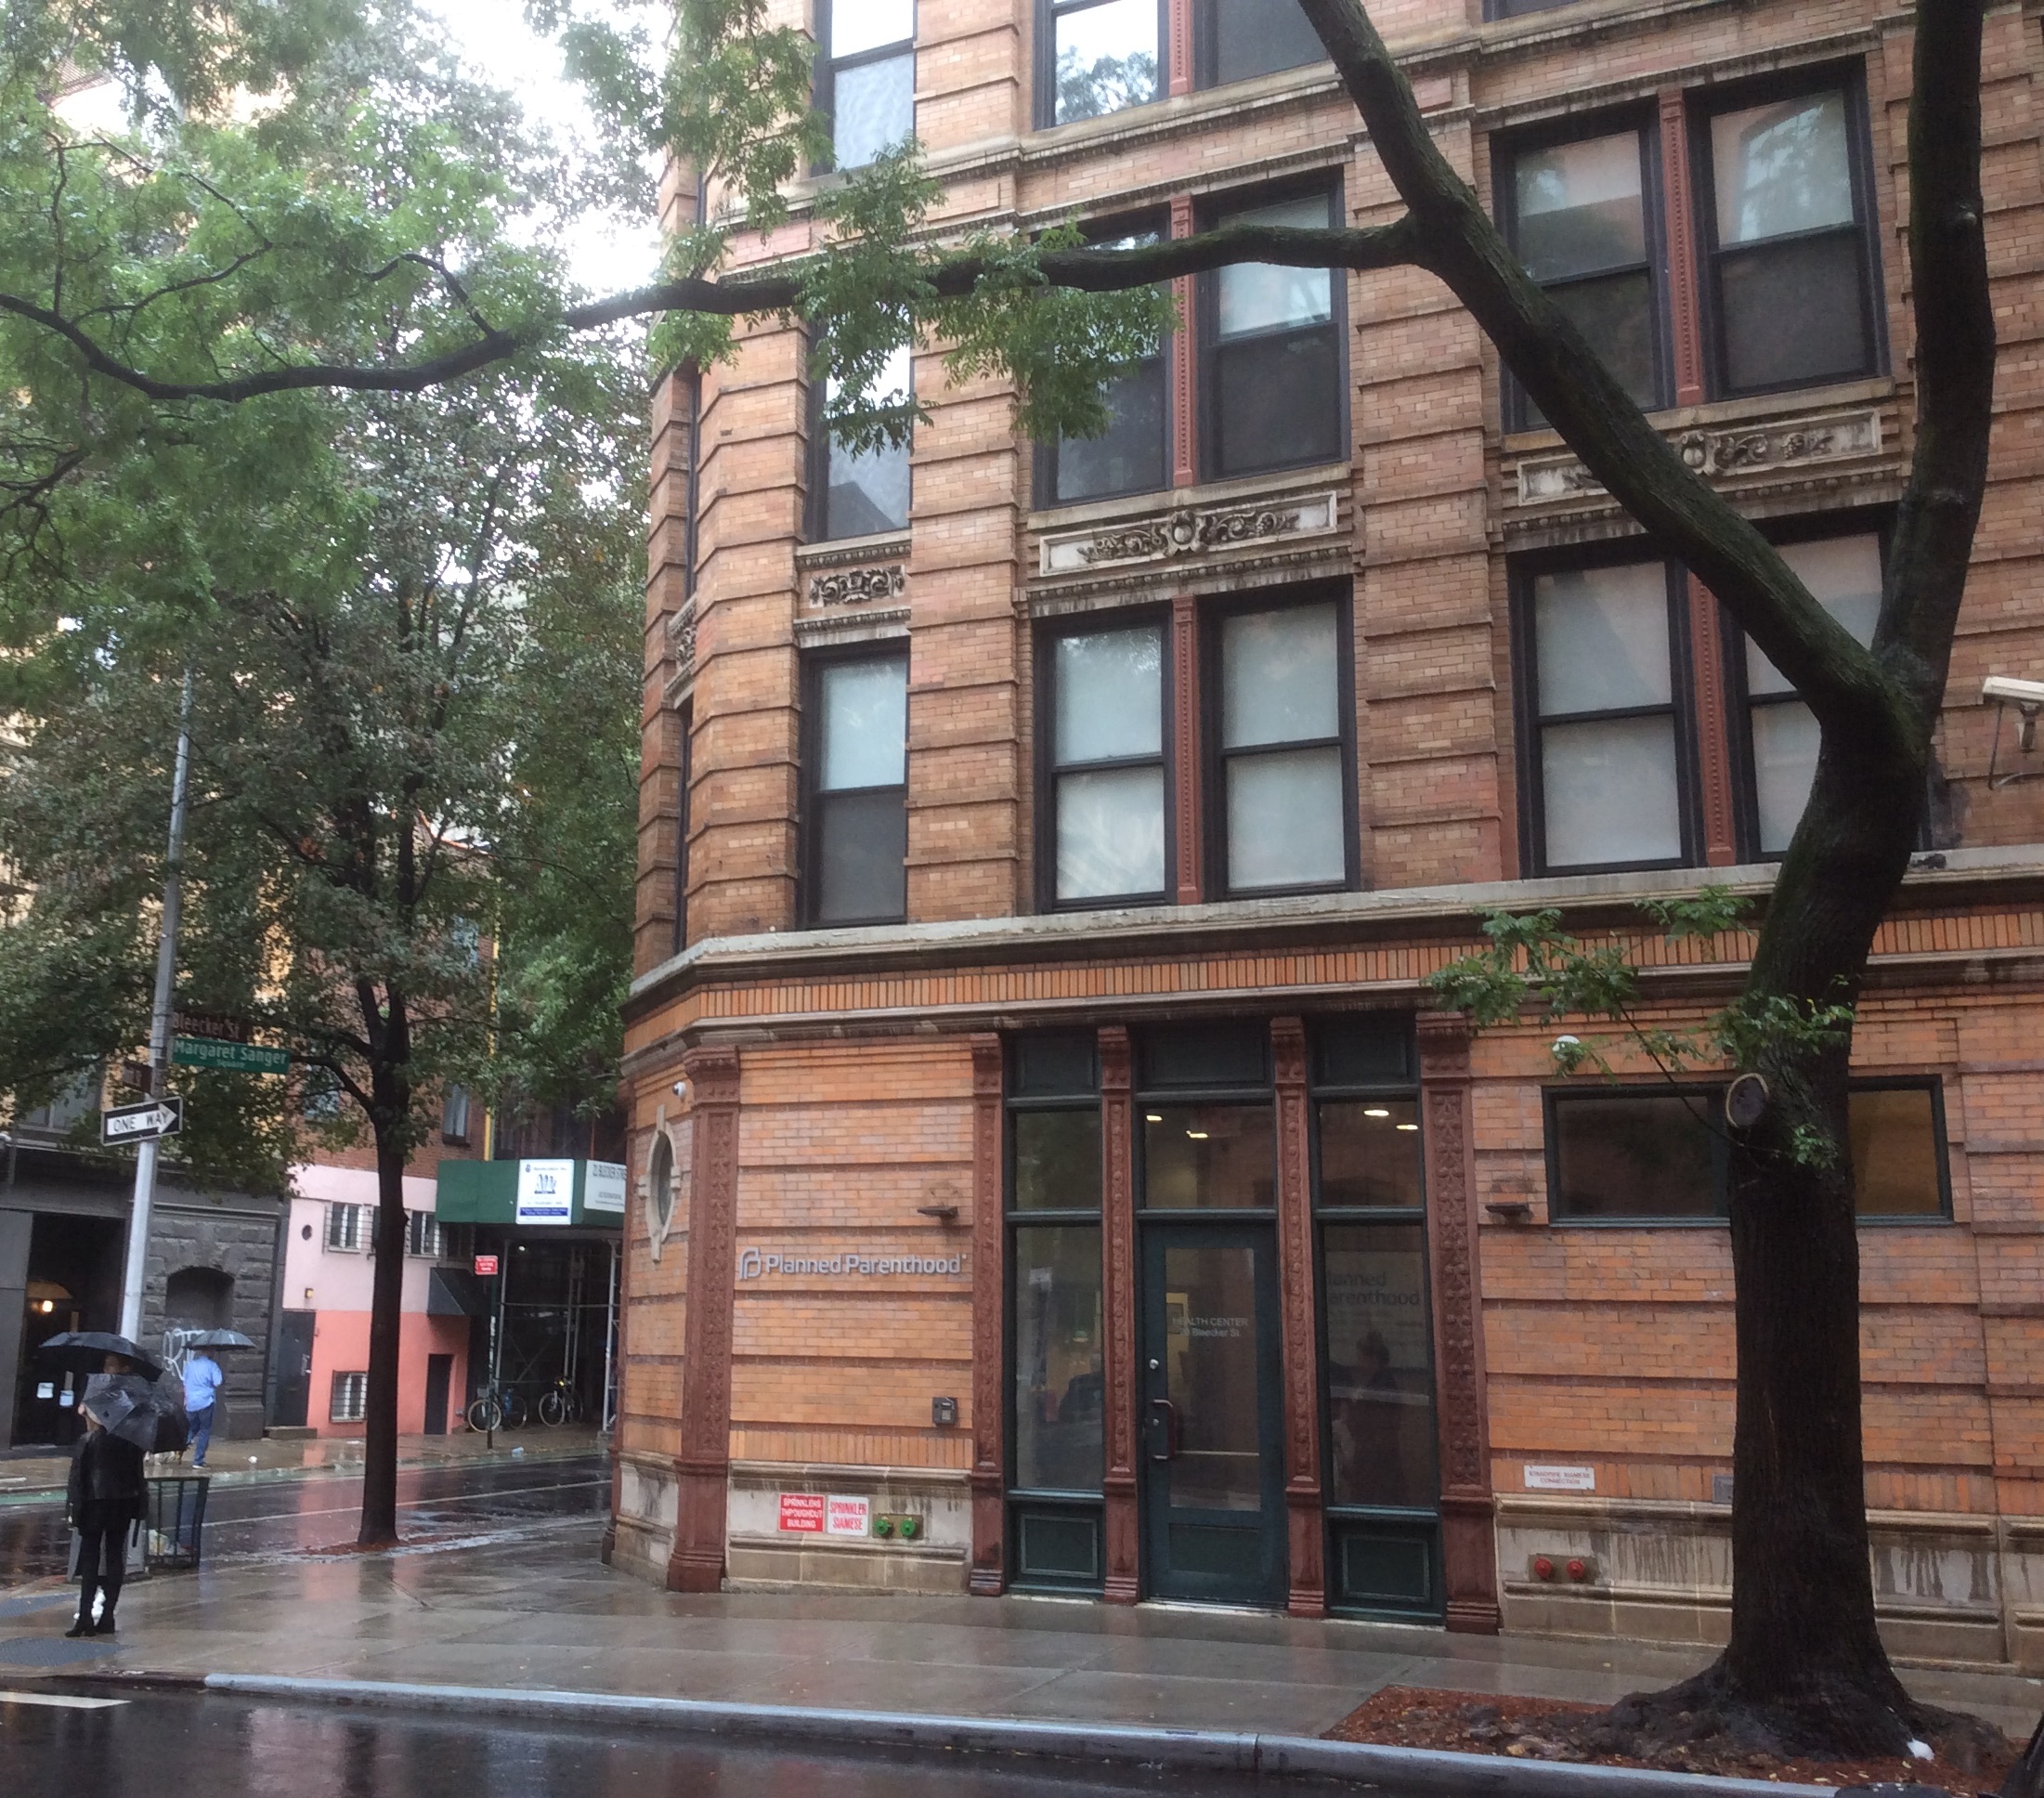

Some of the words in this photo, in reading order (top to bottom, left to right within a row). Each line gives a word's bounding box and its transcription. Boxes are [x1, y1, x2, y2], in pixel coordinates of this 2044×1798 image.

[172, 1011, 224, 1036] Bleecker
[174, 1039, 236, 1060] Margaret
[241, 1047, 287, 1066] Sanger
[113, 1116, 137, 1133] ONE
[146, 1112, 169, 1127] WAY
[765, 1254, 841, 1273] Planned
[844, 1254, 961, 1274] Parenthood
[1172, 1318, 1207, 1326] HEALTH
[1209, 1318, 1248, 1326] CENTER
[1192, 1327, 1228, 1336] Bleecker
[783, 1497, 822, 1508] SPRINKLERS
[829, 1501, 867, 1516] SPRINKLER
[781, 1507, 823, 1518] THROUGHOUT
[787, 1518, 816, 1529] BUILDING
[832, 1517, 863, 1531] SIAMESE
